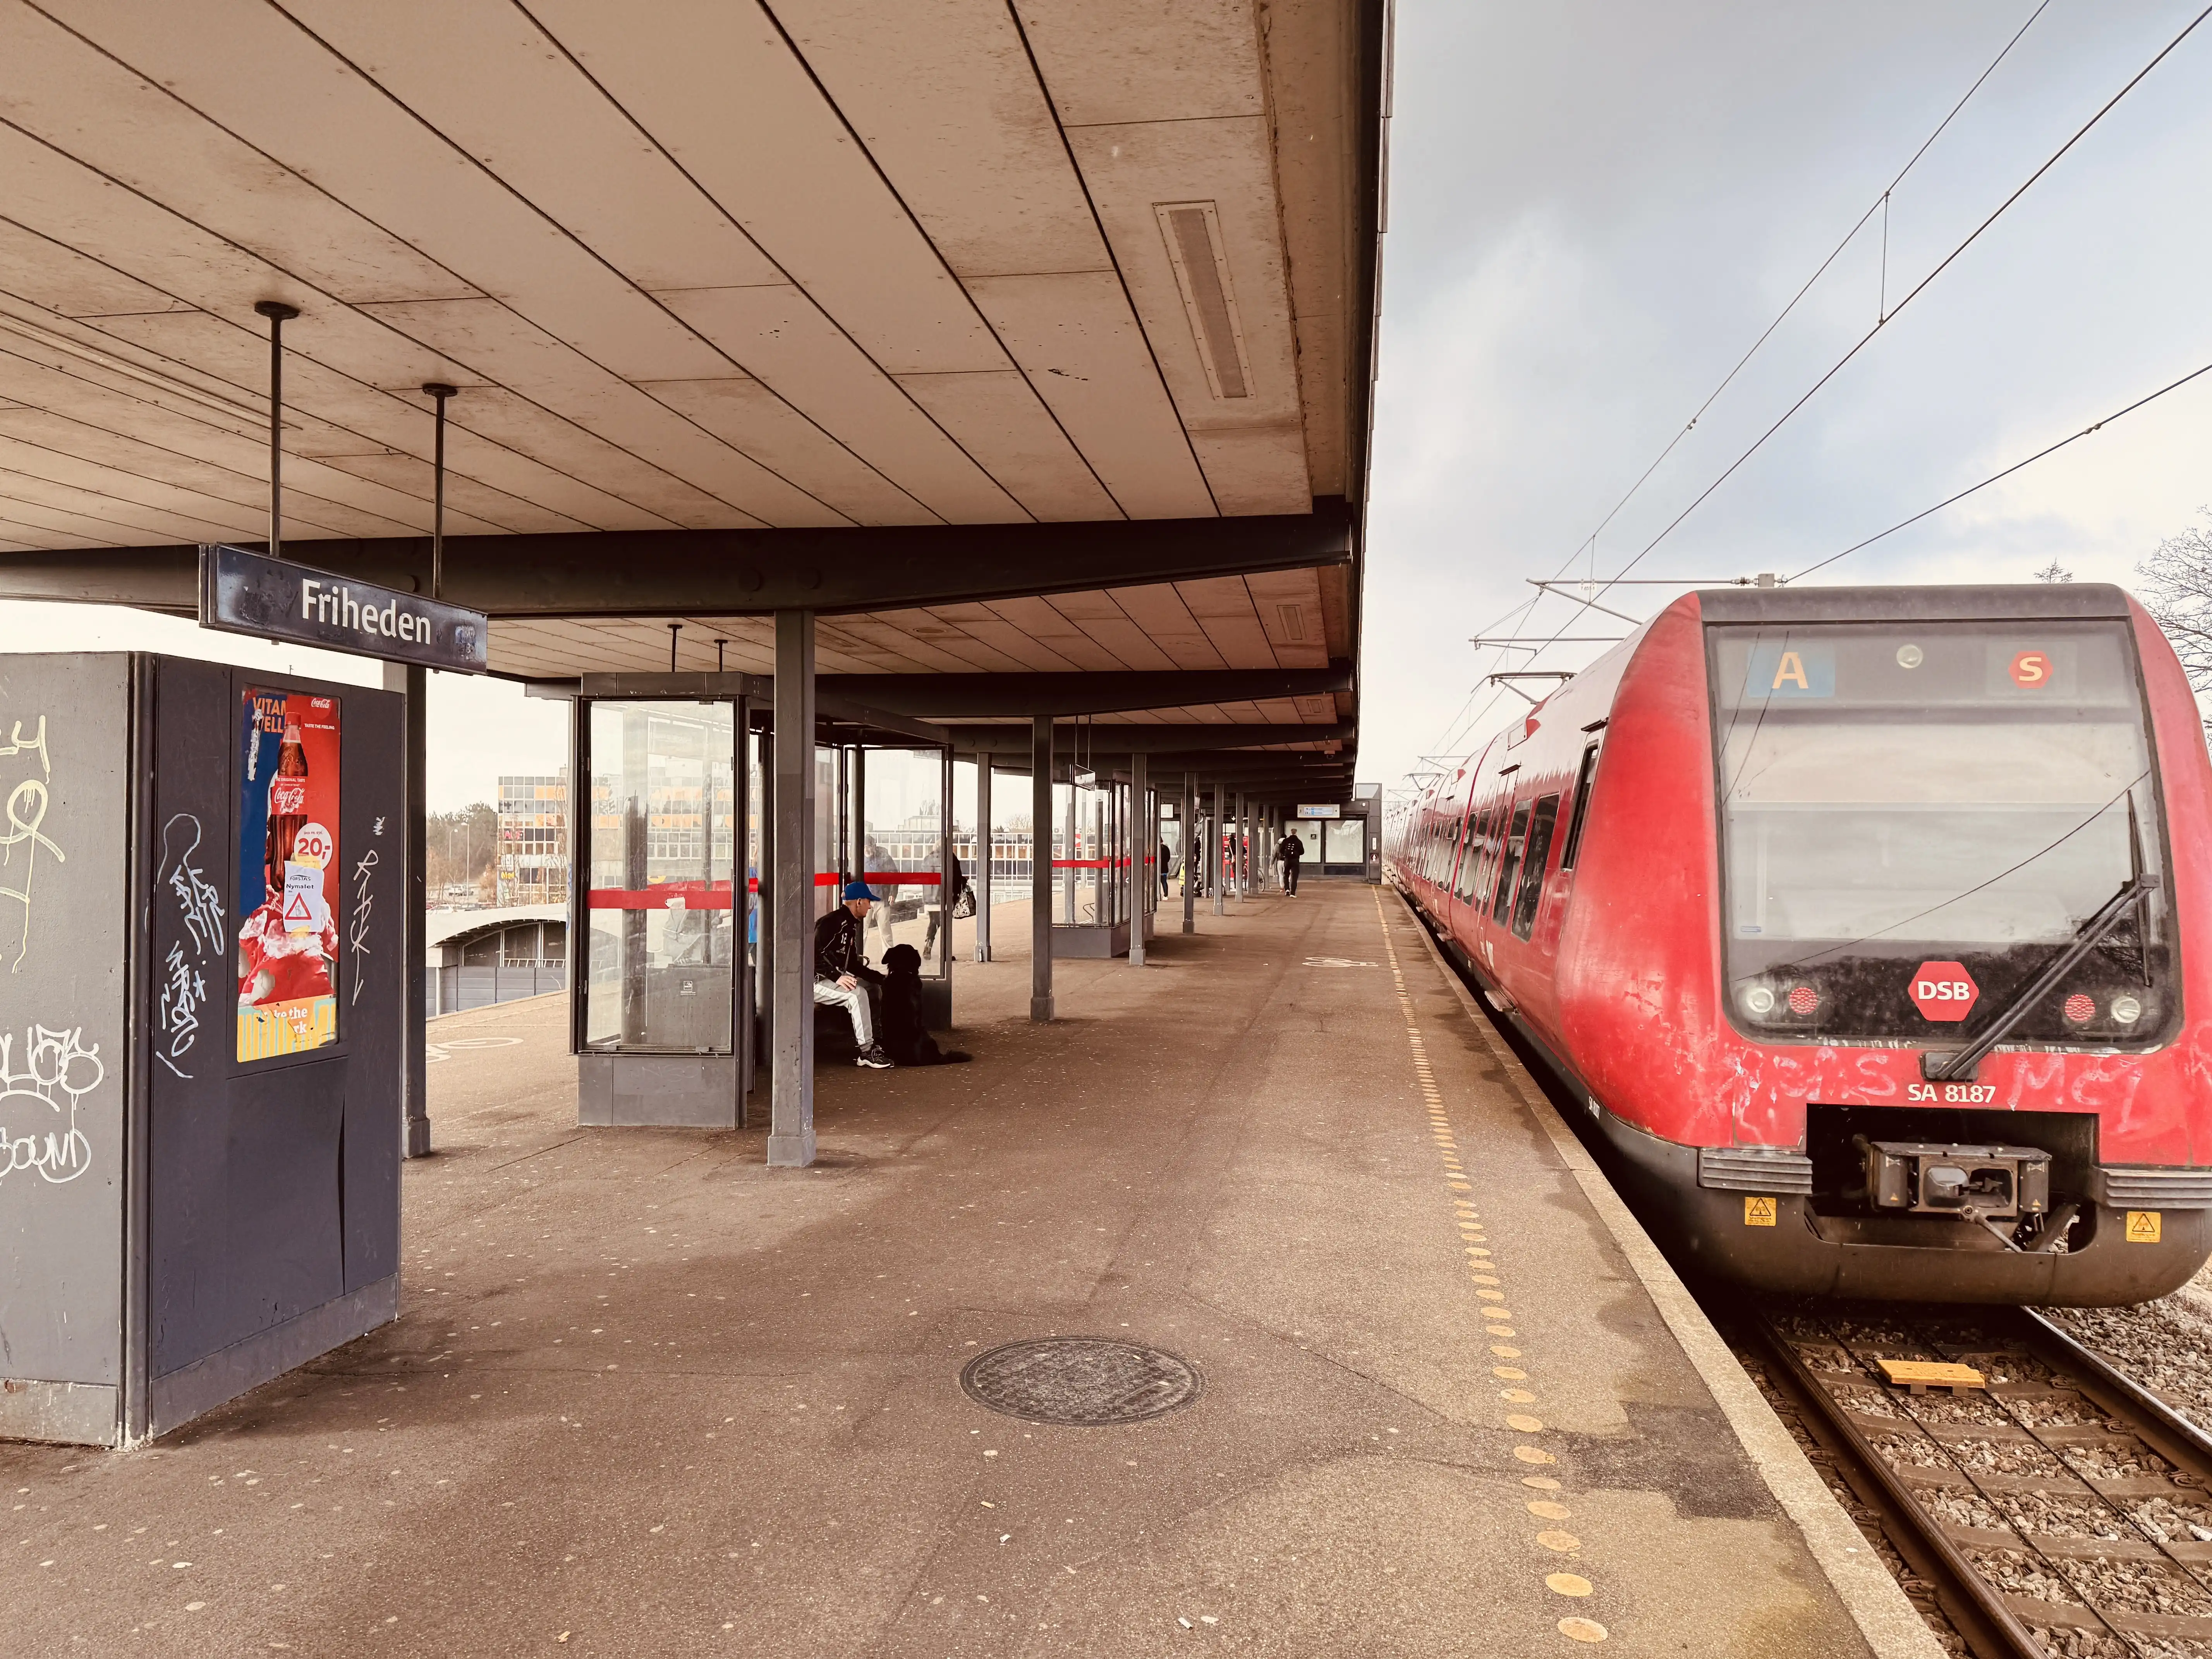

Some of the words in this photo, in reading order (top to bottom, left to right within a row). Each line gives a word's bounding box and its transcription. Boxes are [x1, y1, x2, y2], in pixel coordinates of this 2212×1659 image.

[302, 579, 430, 644] Friheden
[1772, 652, 1808, 689] A
[2018, 656, 2043, 682] S
[274, 787, 305, 804] Coca-Cola
[1918, 981, 1970, 1000] DSB
[289, 1006, 307, 1019] the
[1908, 1084, 1938, 1102] SA
[1945, 1085, 1996, 1103] 8187
